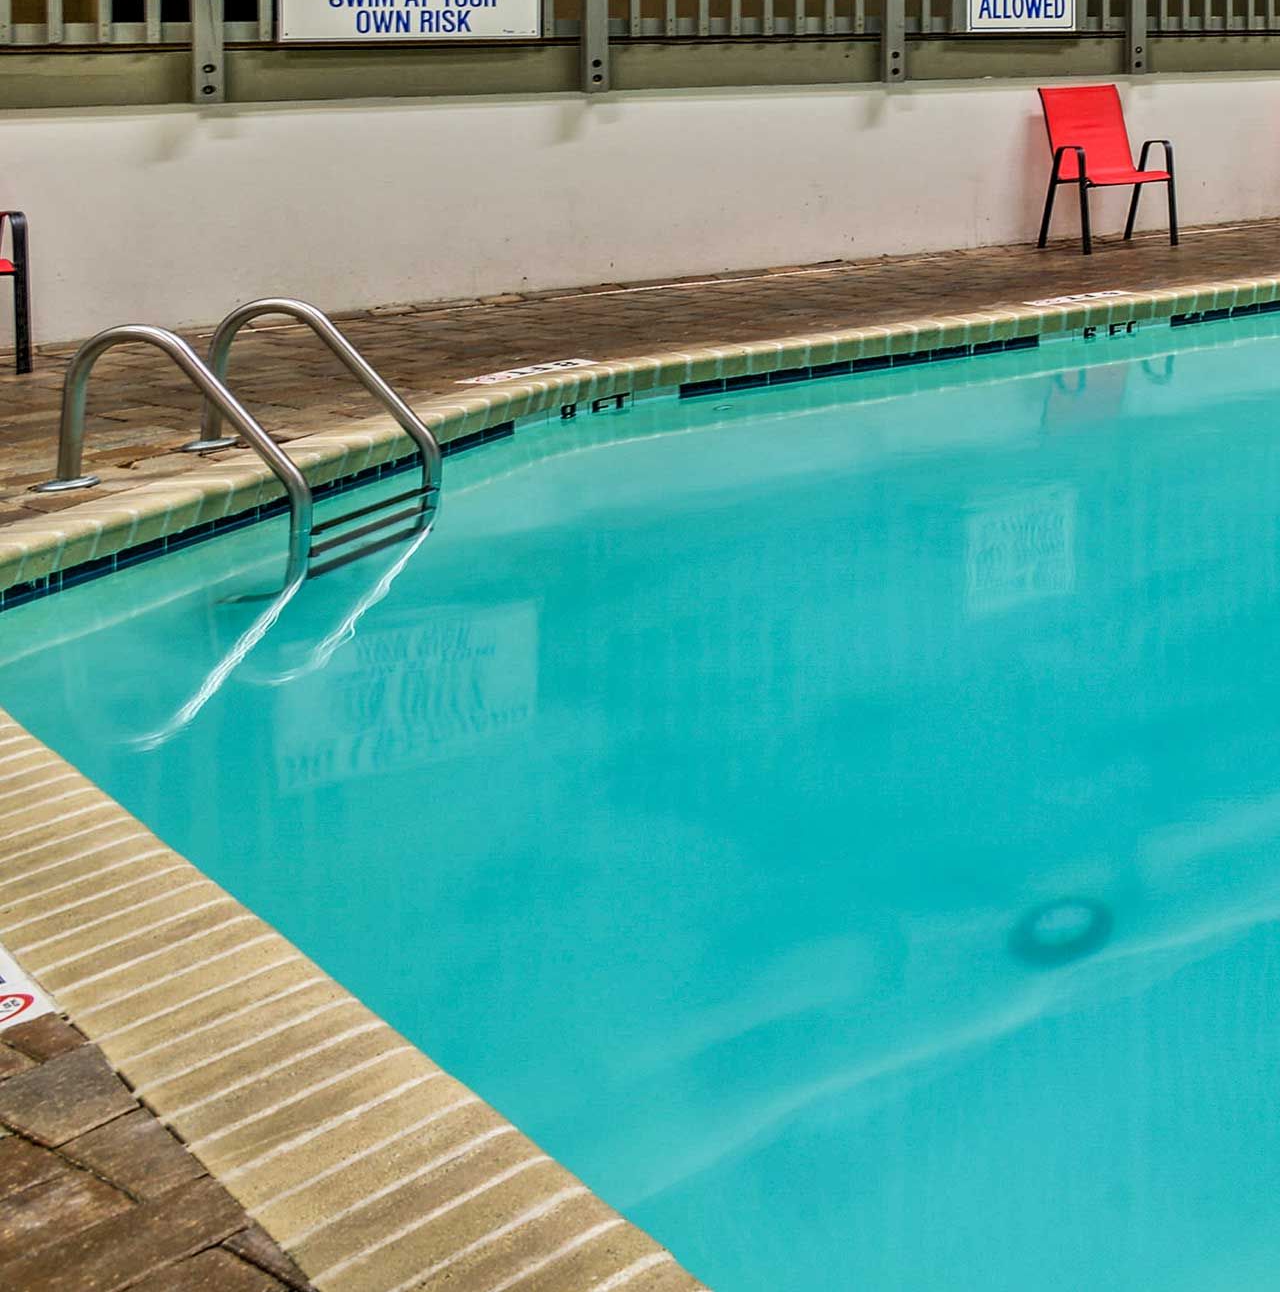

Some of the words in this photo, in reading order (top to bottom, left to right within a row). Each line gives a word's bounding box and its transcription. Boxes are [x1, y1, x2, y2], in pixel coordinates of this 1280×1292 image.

[356, 10, 411, 34] OWN
[420, 10, 472, 33] RISK
[1083, 326, 1097, 340] 6
[560, 401, 578, 420] 8
[591, 392, 631, 414] FT
